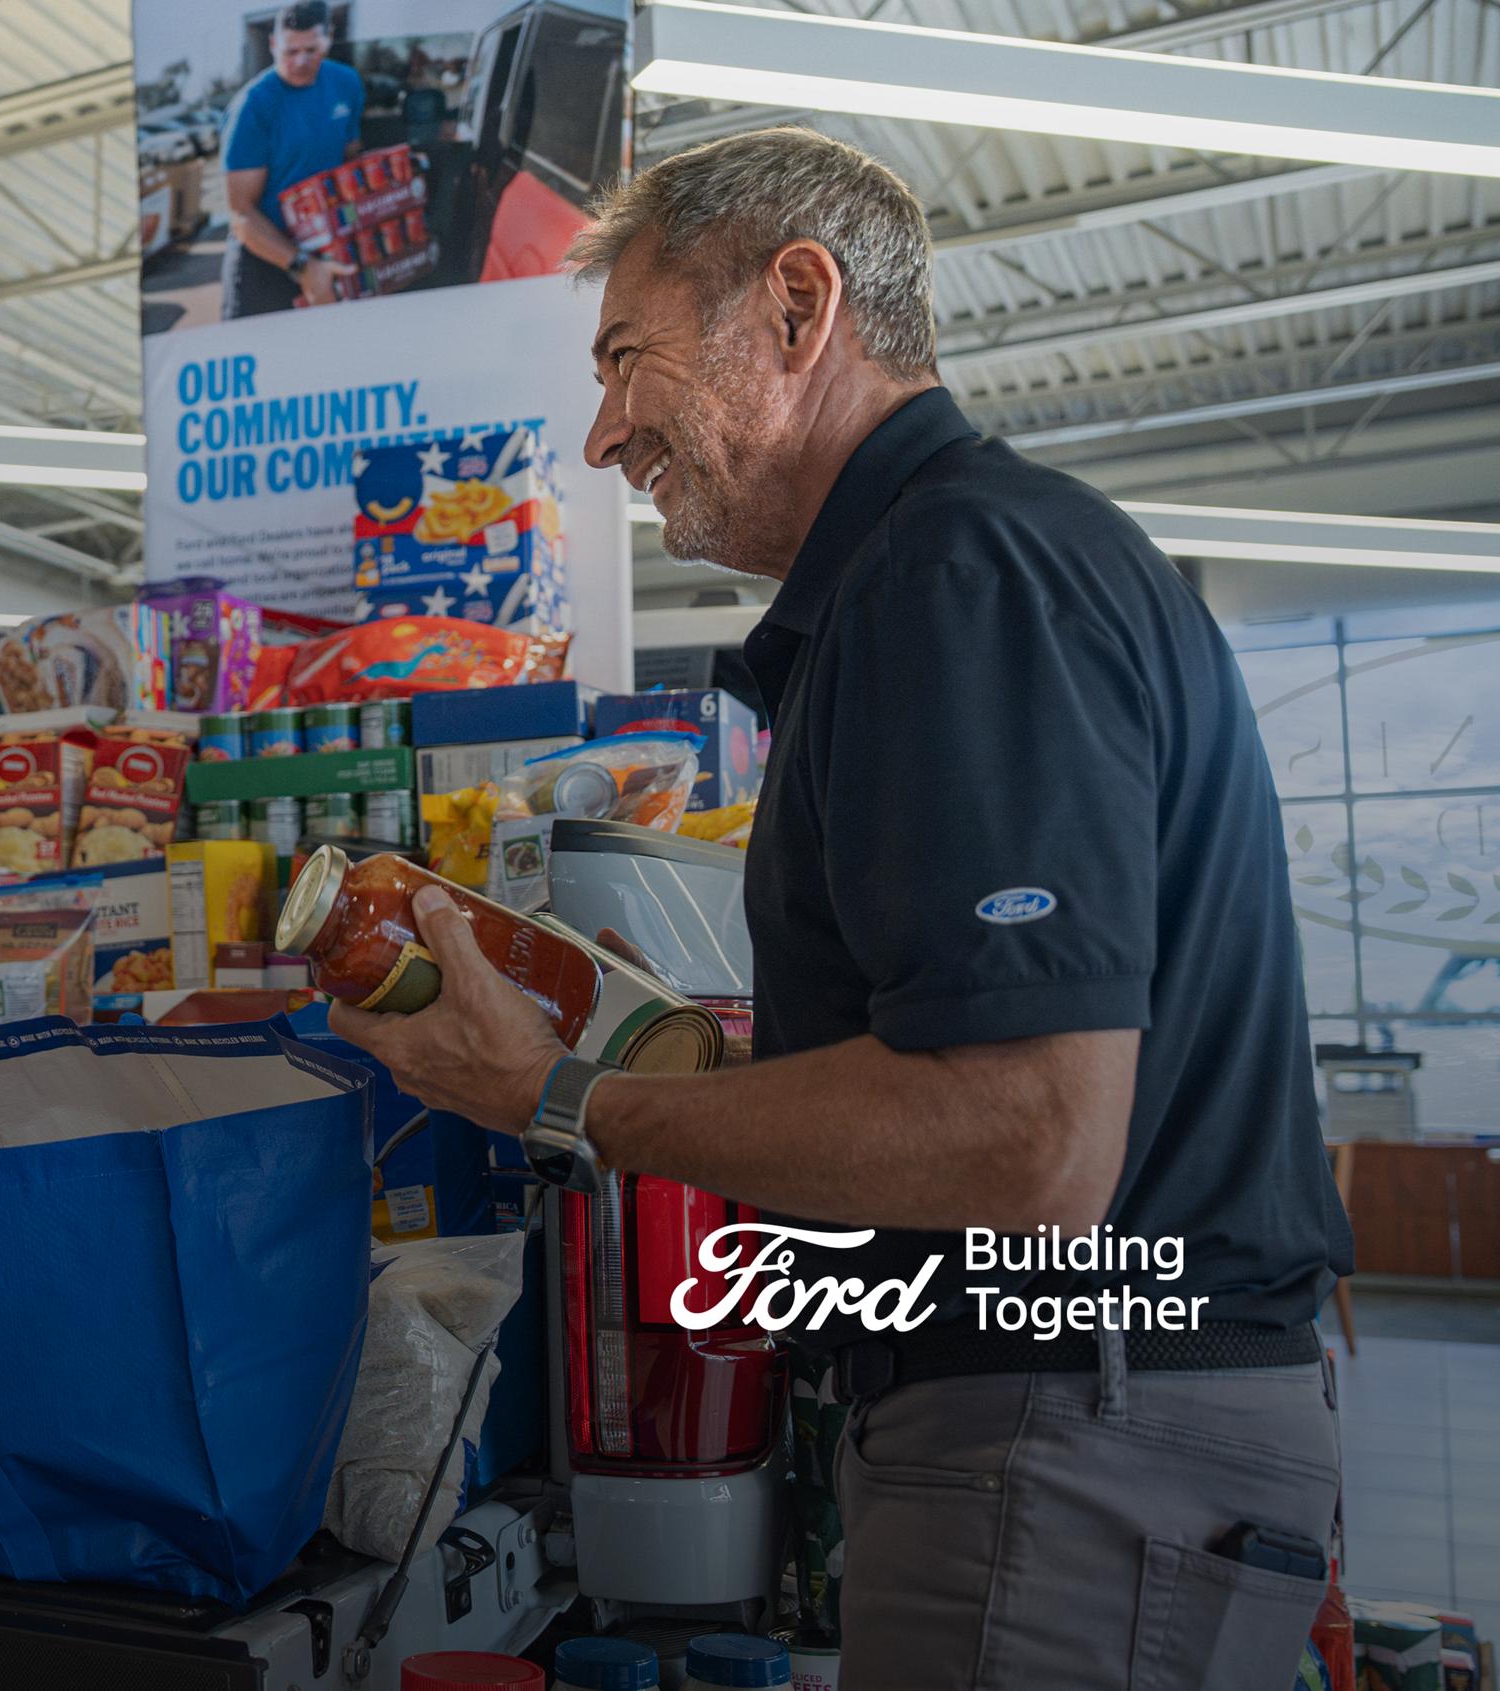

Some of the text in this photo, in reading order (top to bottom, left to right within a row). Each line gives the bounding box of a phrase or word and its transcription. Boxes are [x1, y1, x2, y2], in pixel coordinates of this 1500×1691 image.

[178, 355, 255, 405] OUR
[178, 381, 426, 454] COMMUNITY.
[178, 454, 255, 503] OUR
[700, 693, 717, 716] 6
[992, 895, 1040, 917] Ford
